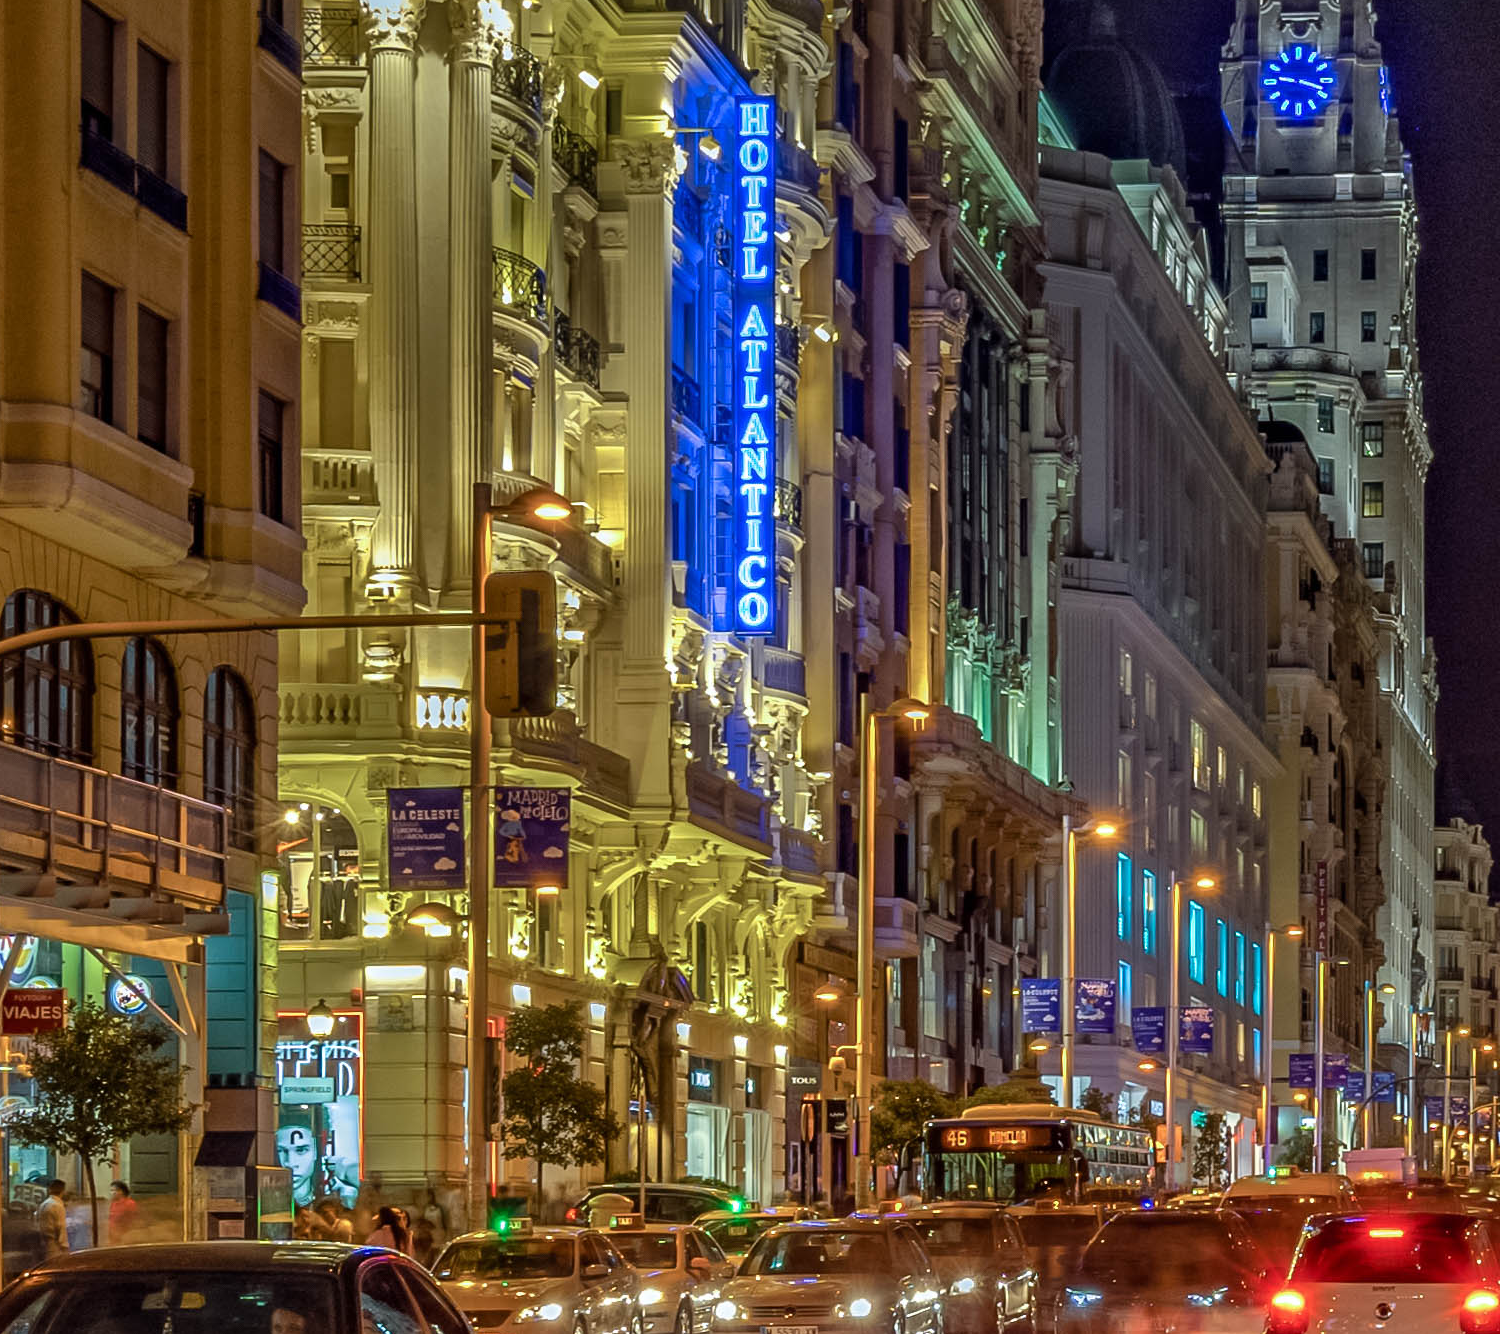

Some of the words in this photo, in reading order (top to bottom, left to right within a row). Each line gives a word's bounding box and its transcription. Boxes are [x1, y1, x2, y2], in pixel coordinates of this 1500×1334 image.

[739, 103, 770, 281] HOTEL
[739, 304, 770, 627] ATLANTICO
[507, 789, 559, 806] MADRID
[392, 810, 406, 821] LA
[409, 809, 460, 820] CELESTE
[3, 1006, 62, 1020] VIAJES
[791, 1076, 817, 1085] TOUS
[284, 1086, 332, 1094] SPRINGFIELD
[947, 1130, 967, 1146] 46
